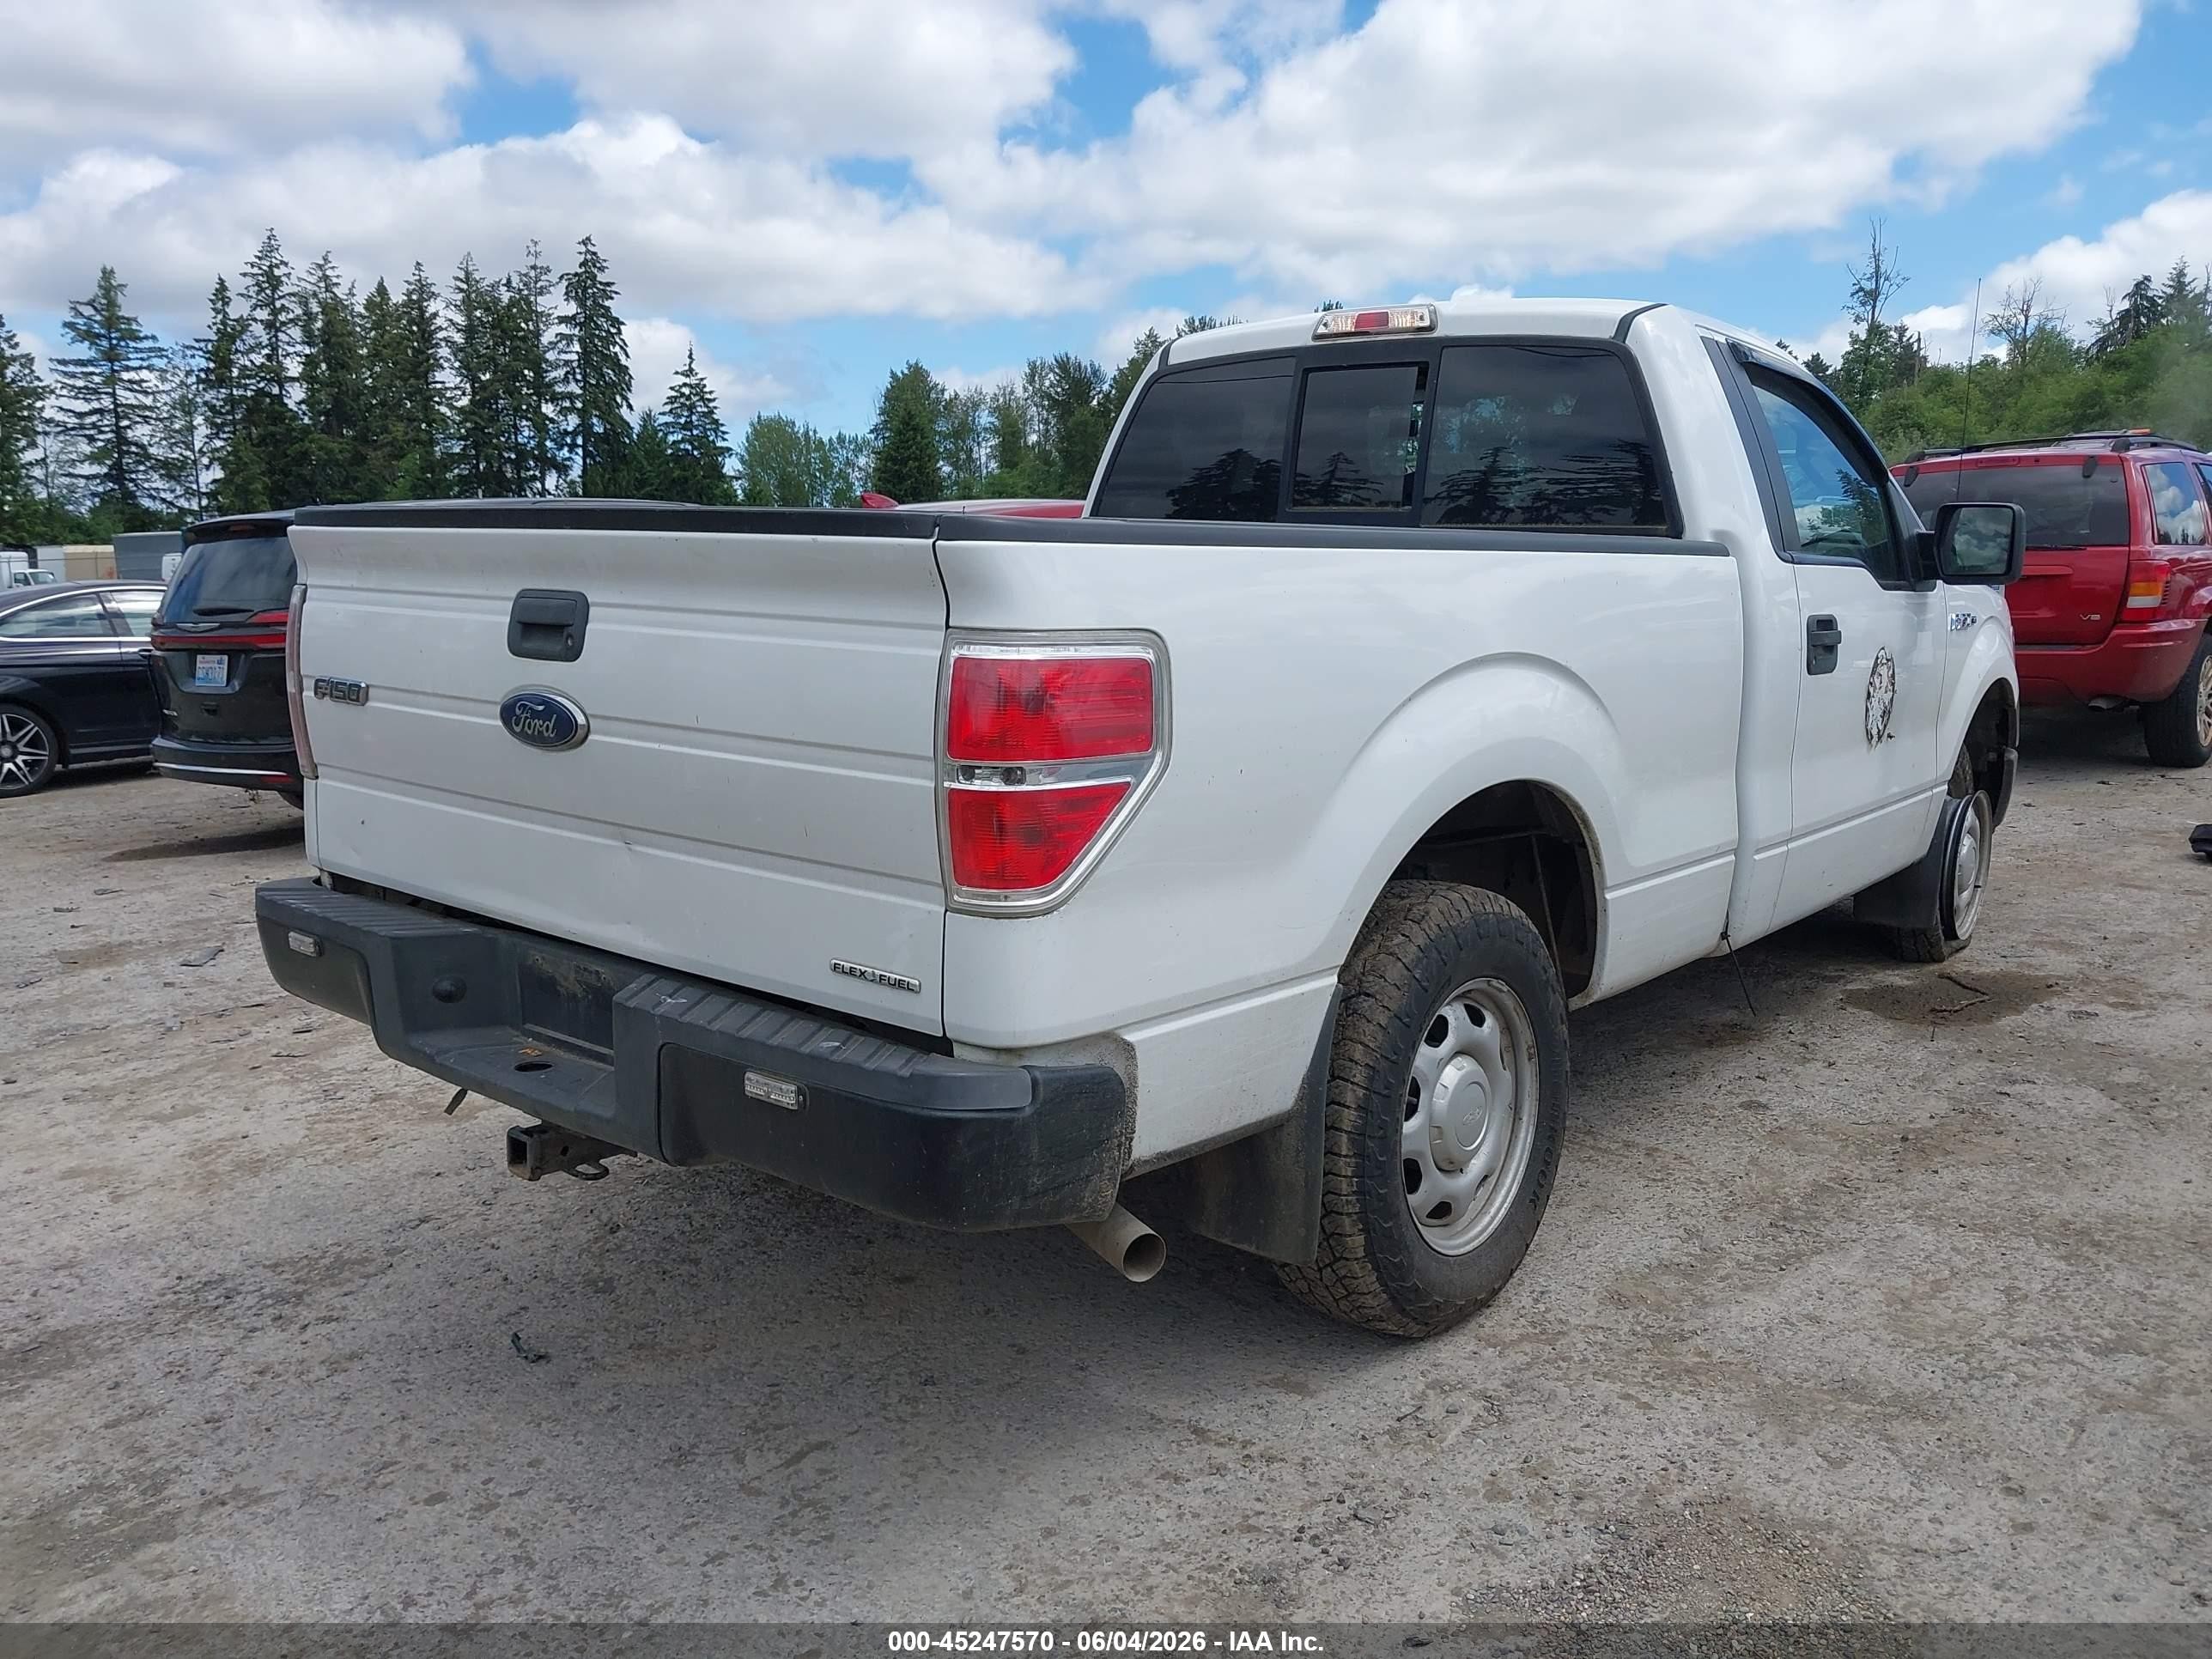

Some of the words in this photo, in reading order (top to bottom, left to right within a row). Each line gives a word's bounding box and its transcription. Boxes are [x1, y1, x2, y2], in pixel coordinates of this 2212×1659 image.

[512, 701, 557, 738] Ford
[833, 963, 867, 980] FLEX
[878, 973, 915, 992] FUEL
